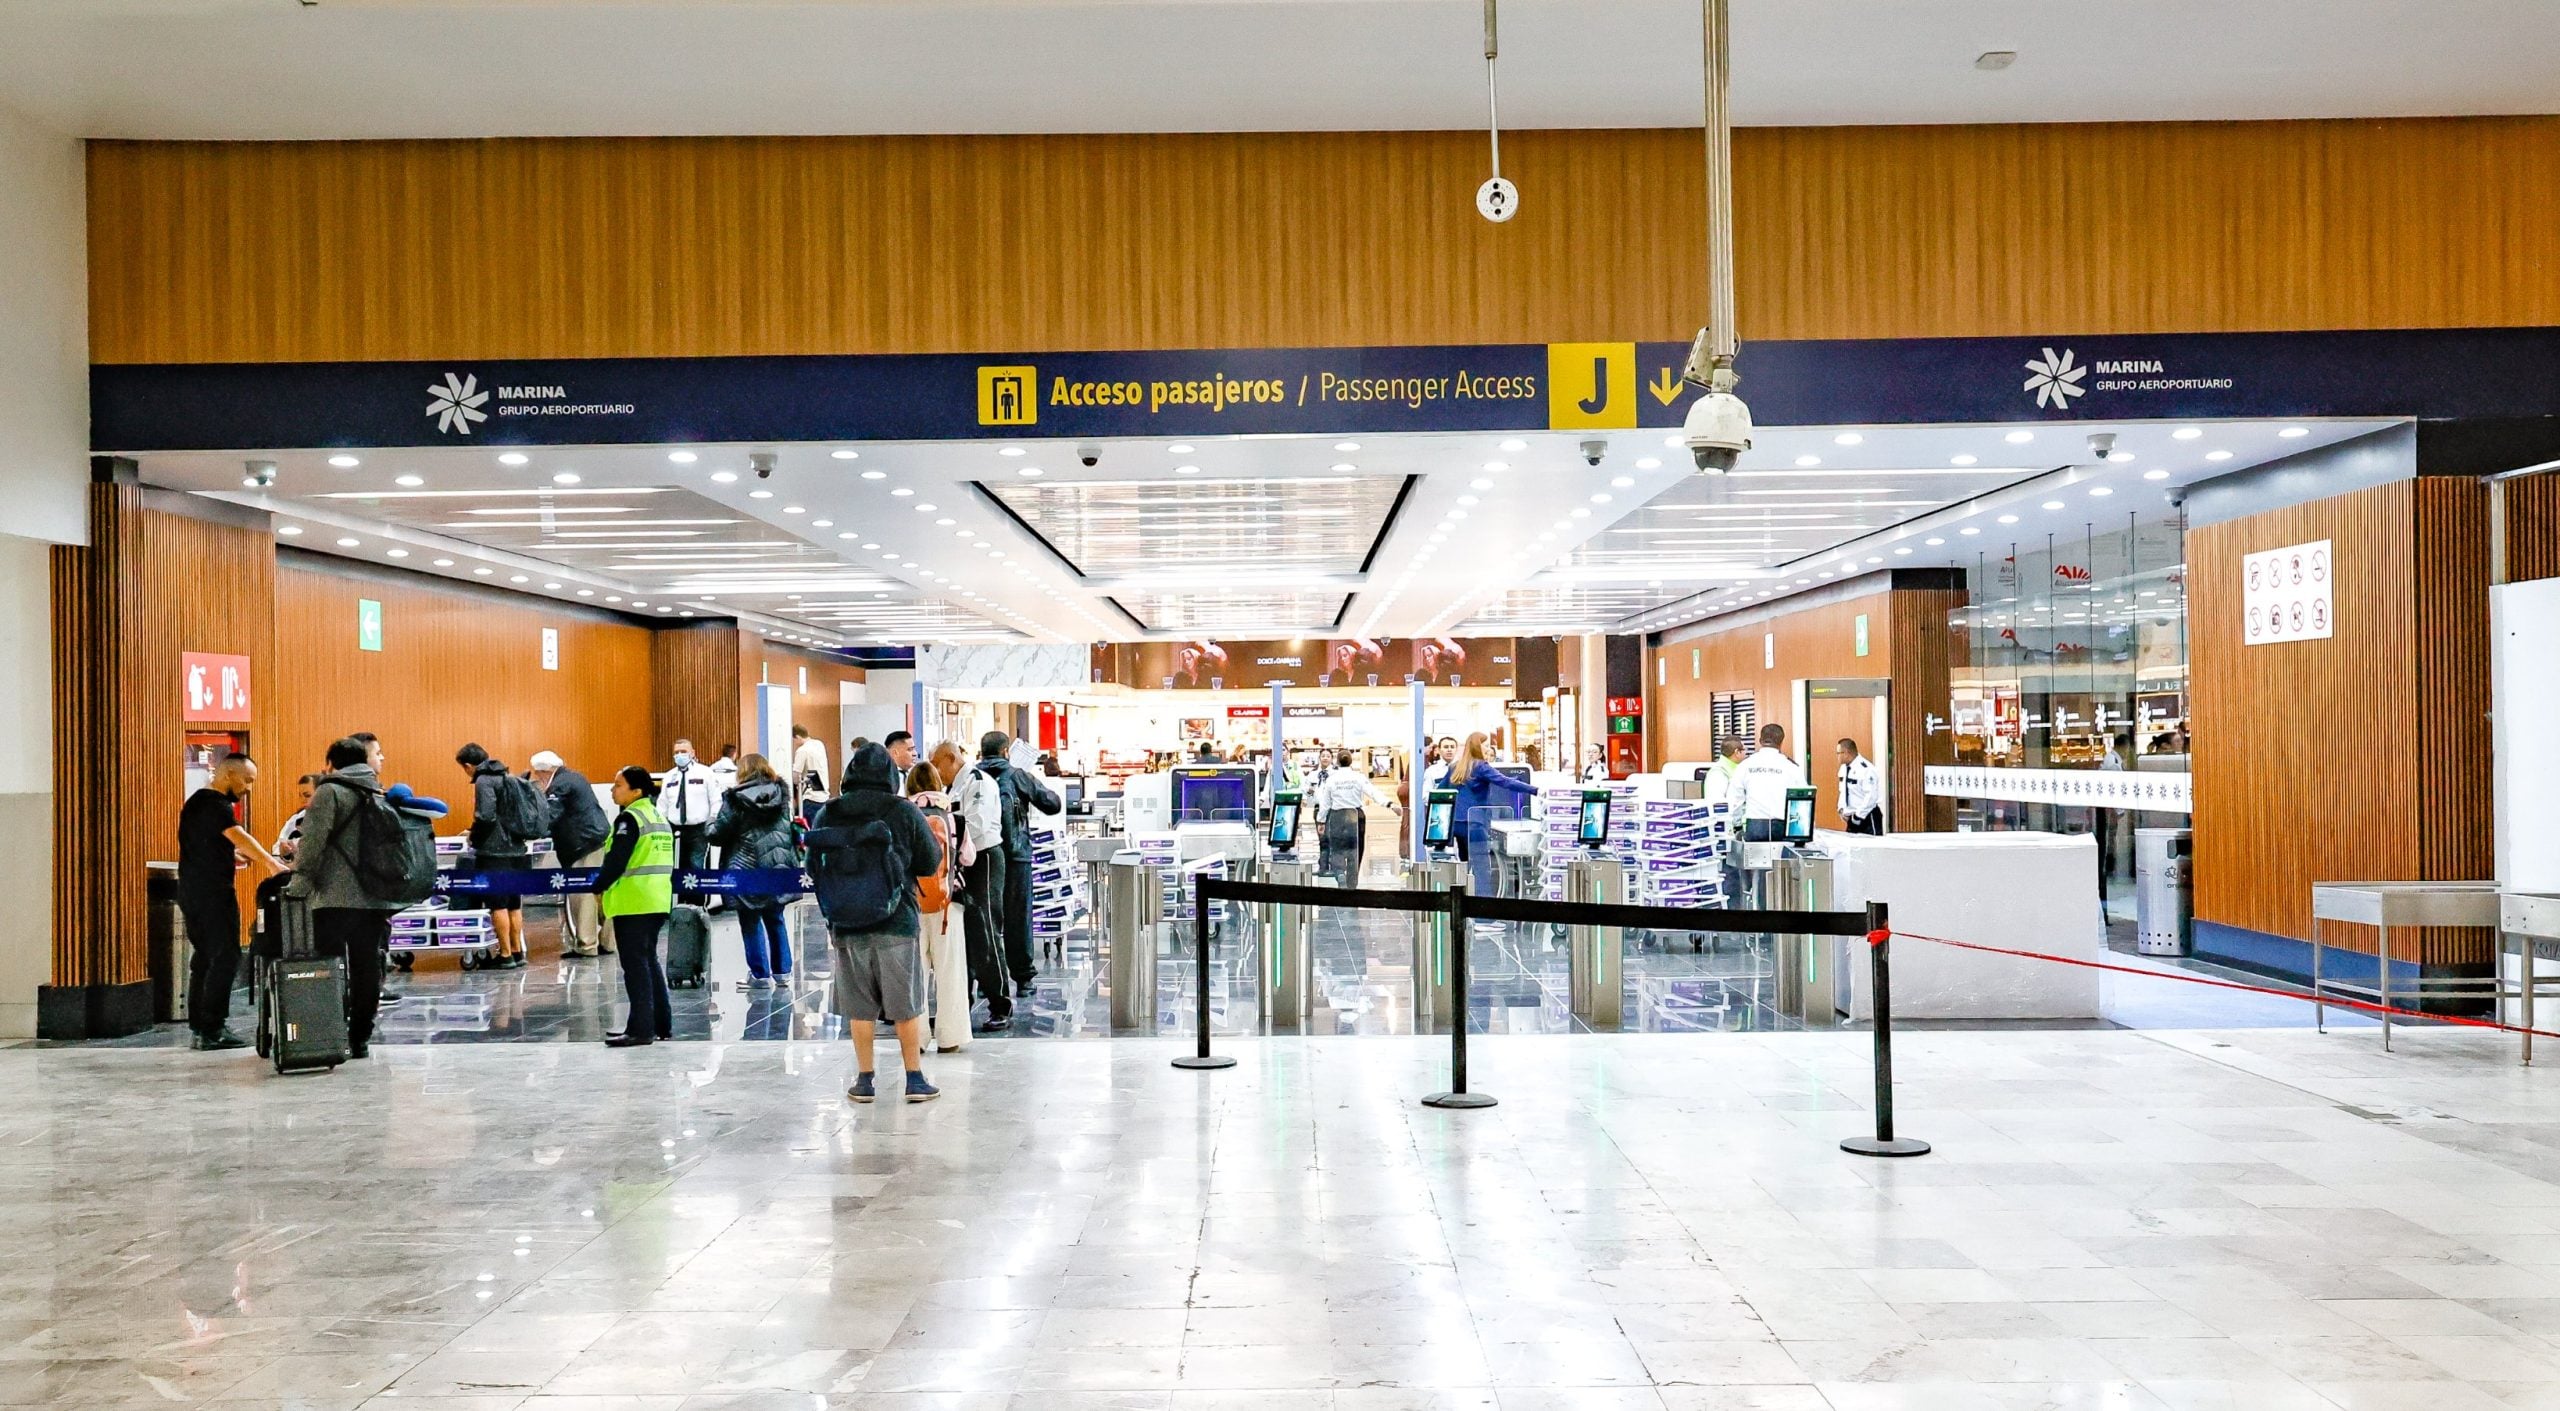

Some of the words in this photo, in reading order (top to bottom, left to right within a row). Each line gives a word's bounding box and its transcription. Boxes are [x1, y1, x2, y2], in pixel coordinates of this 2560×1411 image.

[2096, 360, 2164, 373] MARINA
[1577, 357, 1608, 415] J
[2096, 380, 2137, 390] GRUPO
[2138, 378, 2233, 389] AEROPORTUARIO
[498, 386, 566, 399] MARINA
[1050, 376, 1143, 406] Acceso
[1151, 372, 1284, 413] pasajeros
[1321, 371, 1448, 408] Passenger
[1454, 369, 1535, 399] Access
[499, 406, 539, 416] GRUPO
[540, 404, 635, 415] AEROPORTUARIO
[1289, 708, 1326, 716] GUERLAIN
